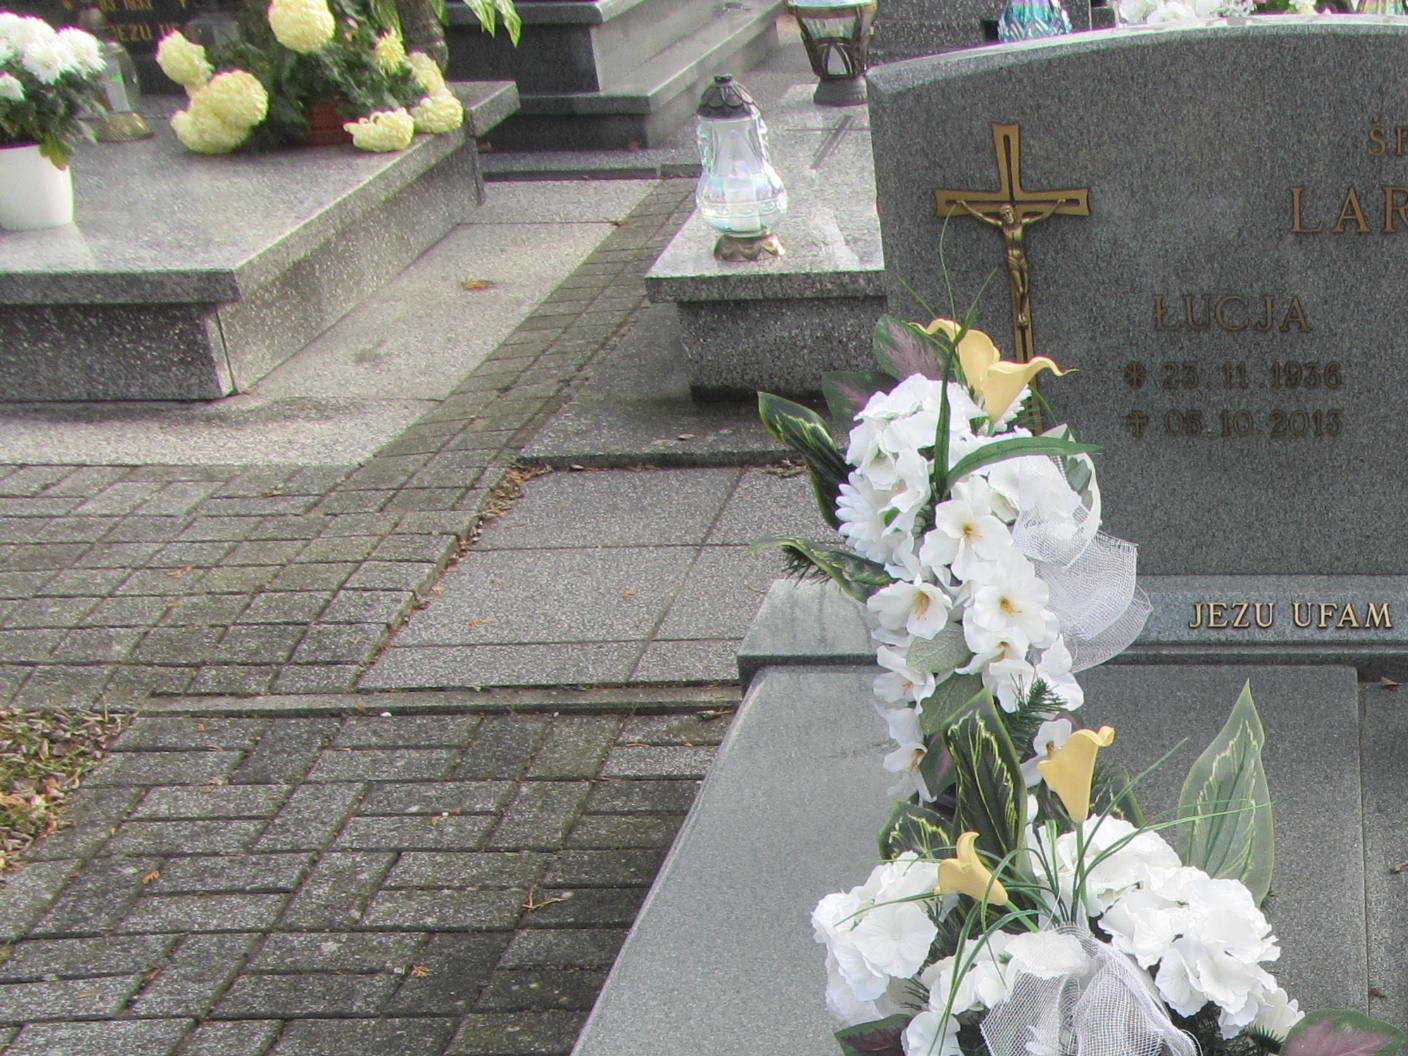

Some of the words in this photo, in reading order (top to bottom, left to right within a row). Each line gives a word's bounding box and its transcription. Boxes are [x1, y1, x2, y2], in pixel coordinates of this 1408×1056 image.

[1152, 294, 1313, 333] ŁUCJA
[1188, 601, 1275, 629] JEZU
[1291, 601, 1394, 629] UFAM
